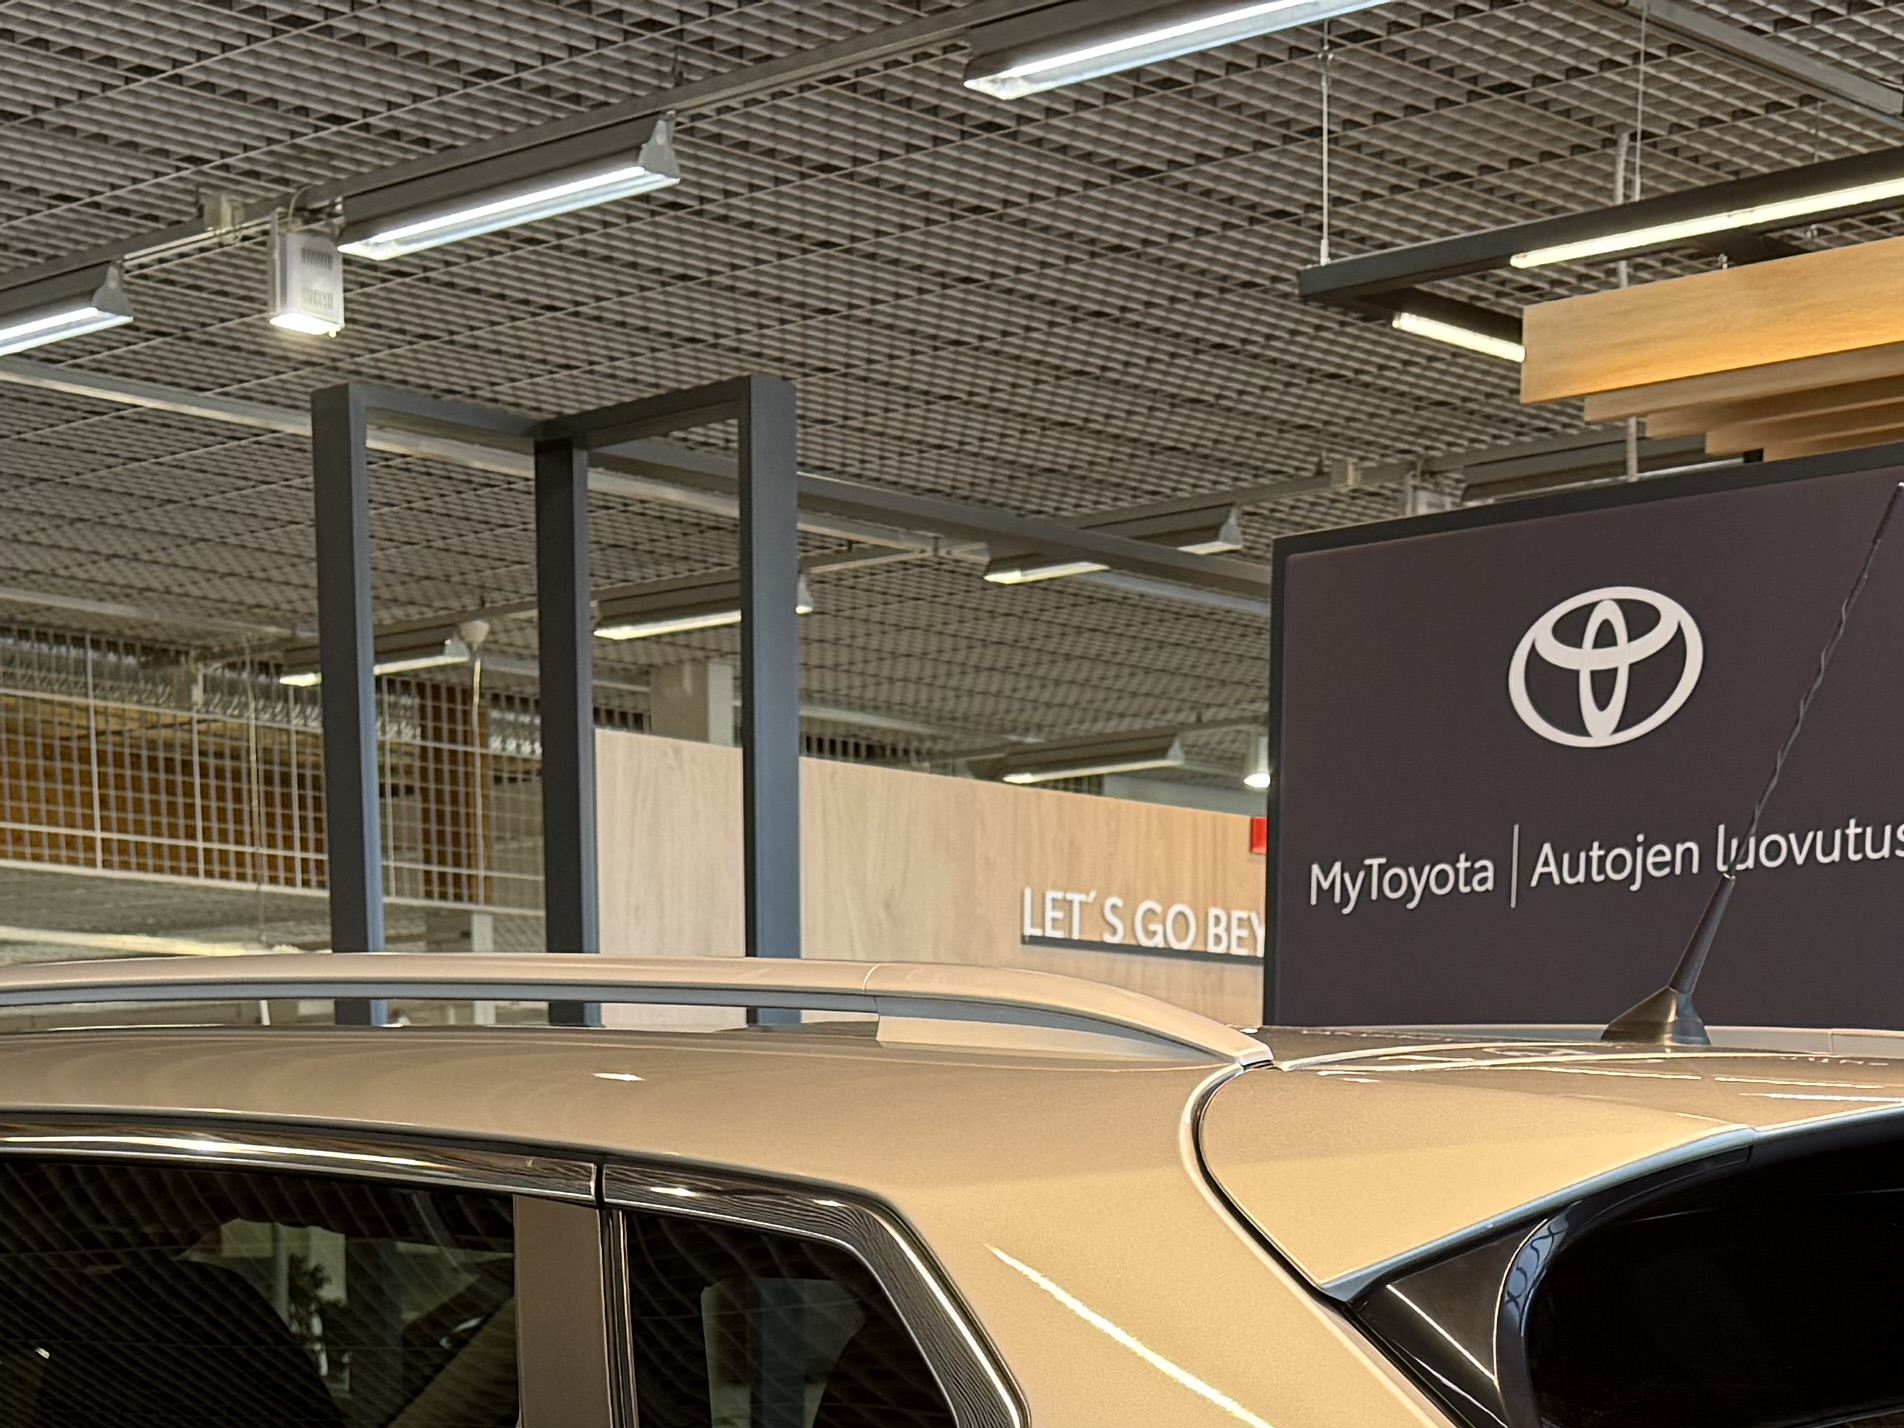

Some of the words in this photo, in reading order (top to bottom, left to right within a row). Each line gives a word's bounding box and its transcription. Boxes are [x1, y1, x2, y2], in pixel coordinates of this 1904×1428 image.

[1309, 851, 1495, 915] MyToyota
[1529, 833, 1700, 892] Autojen
[1134, 899, 1197, 951] GO
